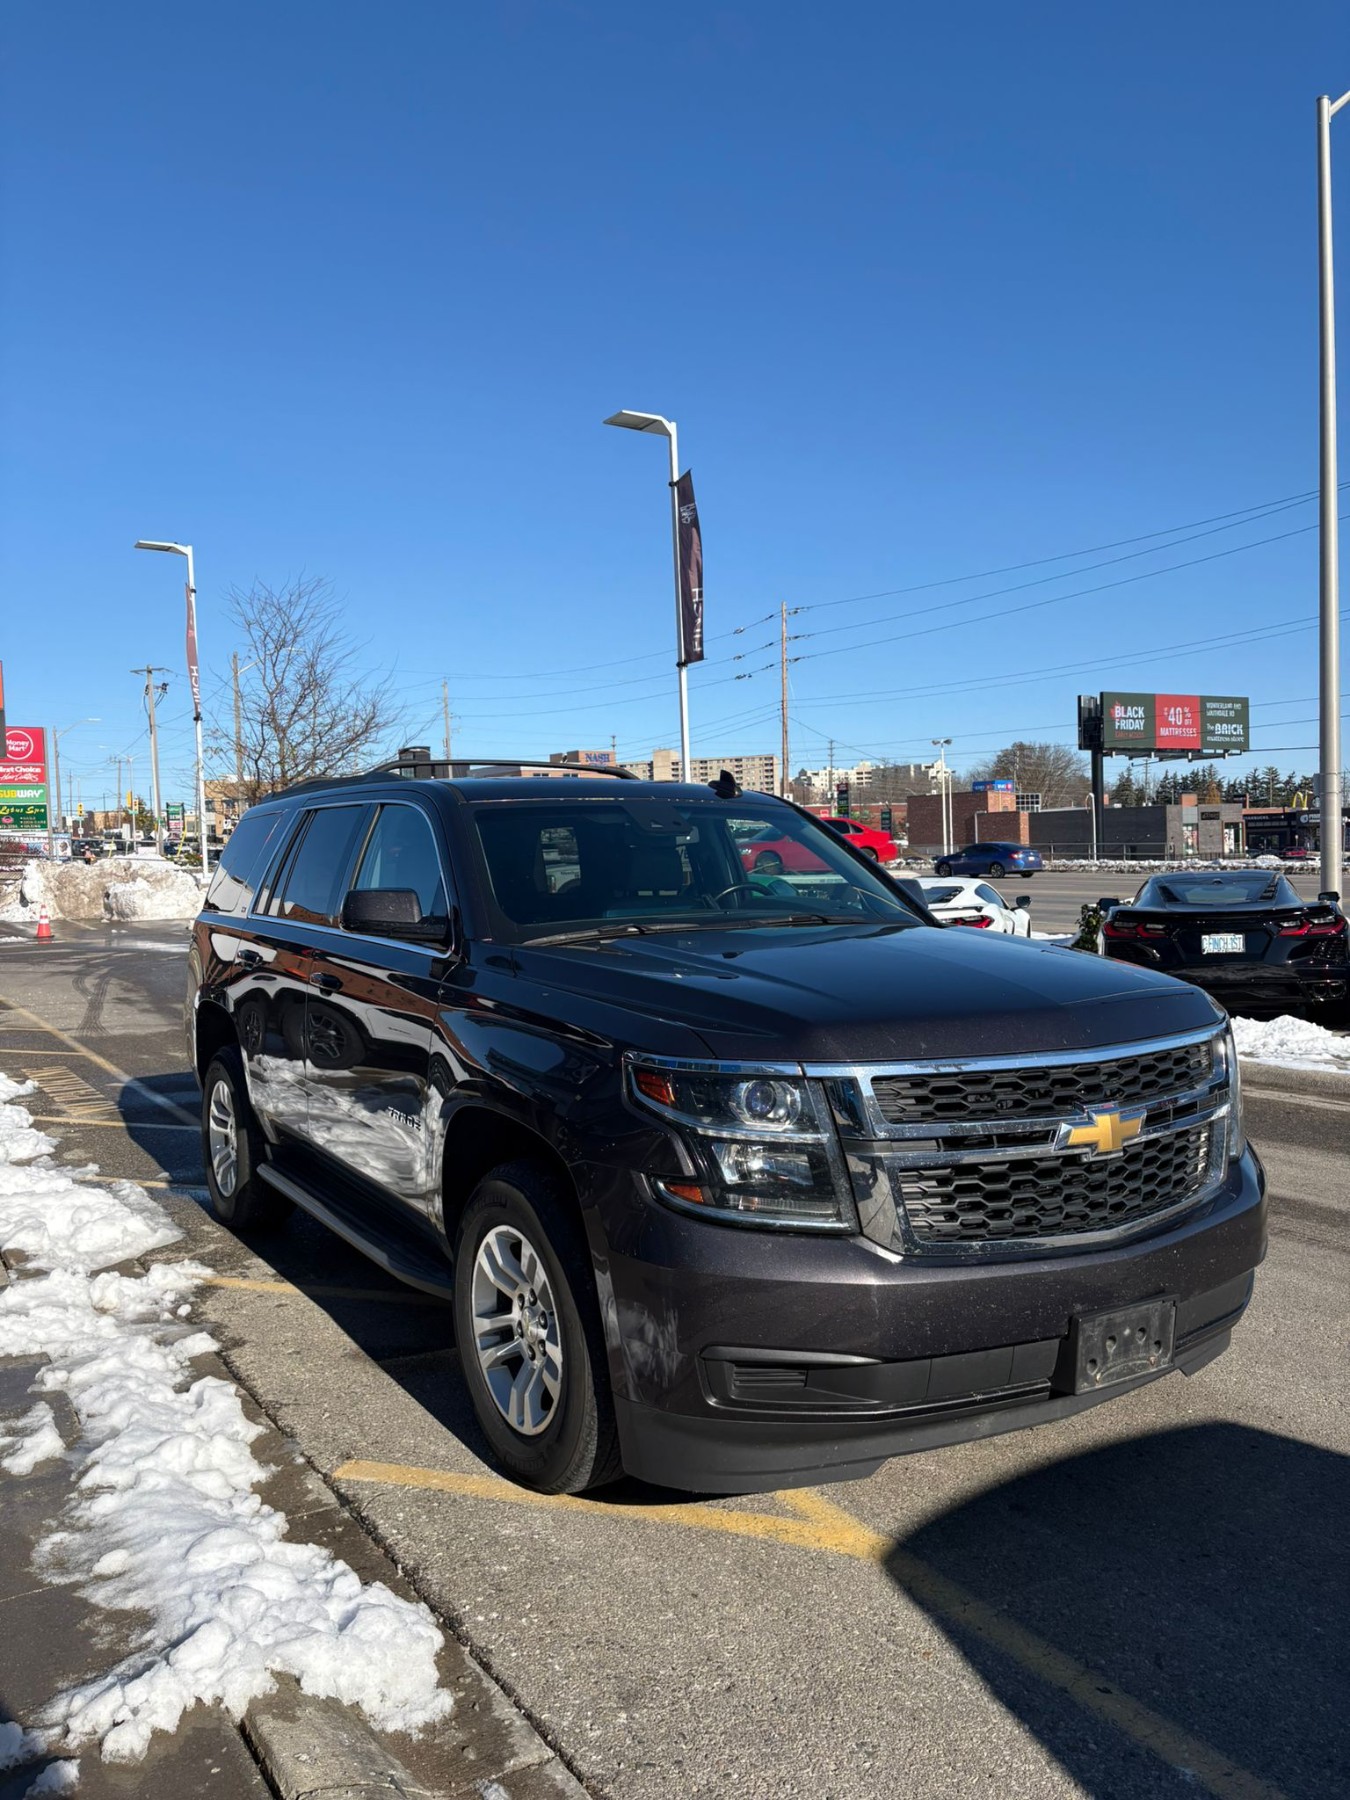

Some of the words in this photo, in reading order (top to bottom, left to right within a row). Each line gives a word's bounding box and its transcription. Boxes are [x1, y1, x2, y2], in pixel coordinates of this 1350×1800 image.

[1114, 706, 1145, 718] BLACK
[1168, 706, 1182, 726] 40
[1115, 719, 1145, 730] FRIDAY
[1215, 723, 1244, 735] BRICK
[1160, 727, 1197, 737] MATTRESSES
[6, 739, 29, 747] Money
[25, 805, 45, 815] Spa
